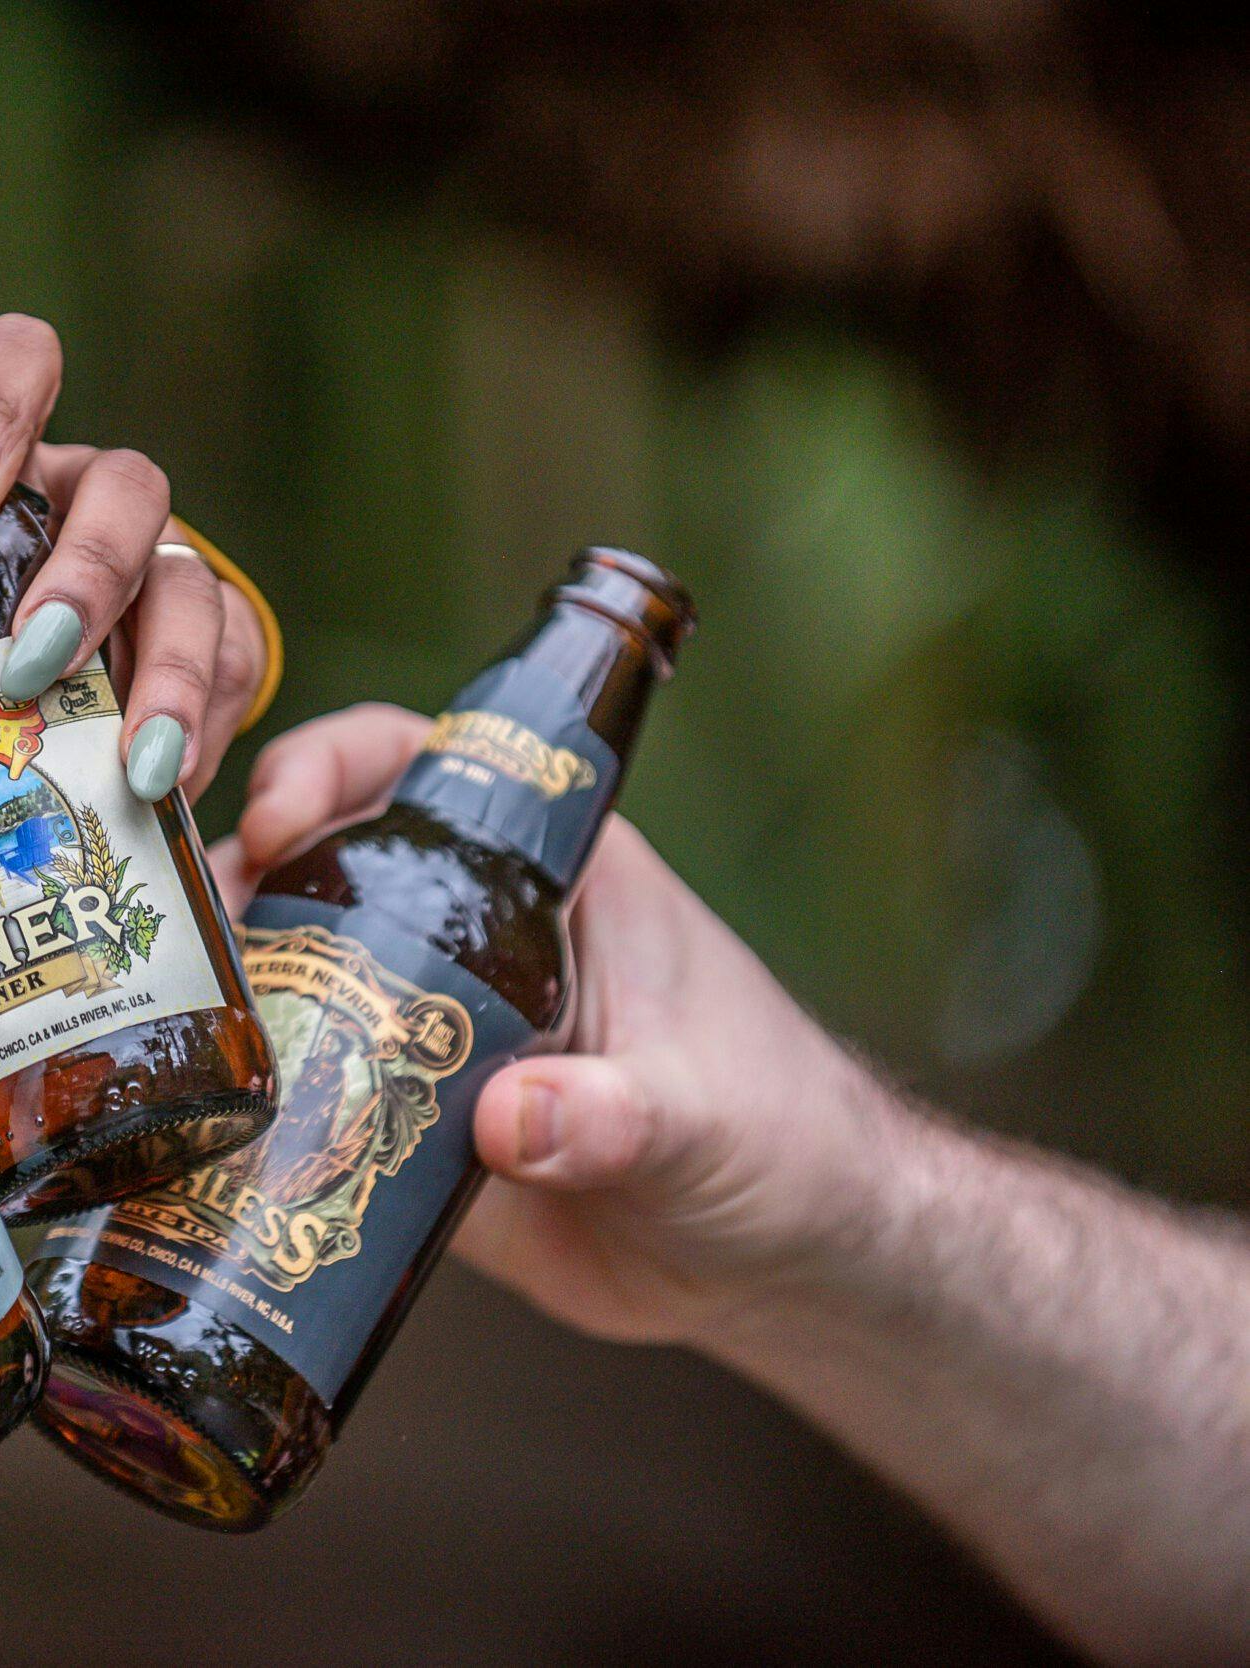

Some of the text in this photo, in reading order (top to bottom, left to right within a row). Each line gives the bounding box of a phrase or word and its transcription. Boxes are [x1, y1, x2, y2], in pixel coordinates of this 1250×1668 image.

[61, 680, 90, 693] Finest
[59, 690, 98, 715] Quality
[310, 968, 383, 1028] NEVADA
[28, 1032, 43, 1046] CA
[43, 1028, 51, 1040] &
[50, 1016, 80, 1036] MILLS
[79, 1005, 113, 1026] RIVER,
[111, 999, 130, 1014] NC,
[181, 1216, 231, 1251] IPA
[178, 1257, 194, 1273] CA
